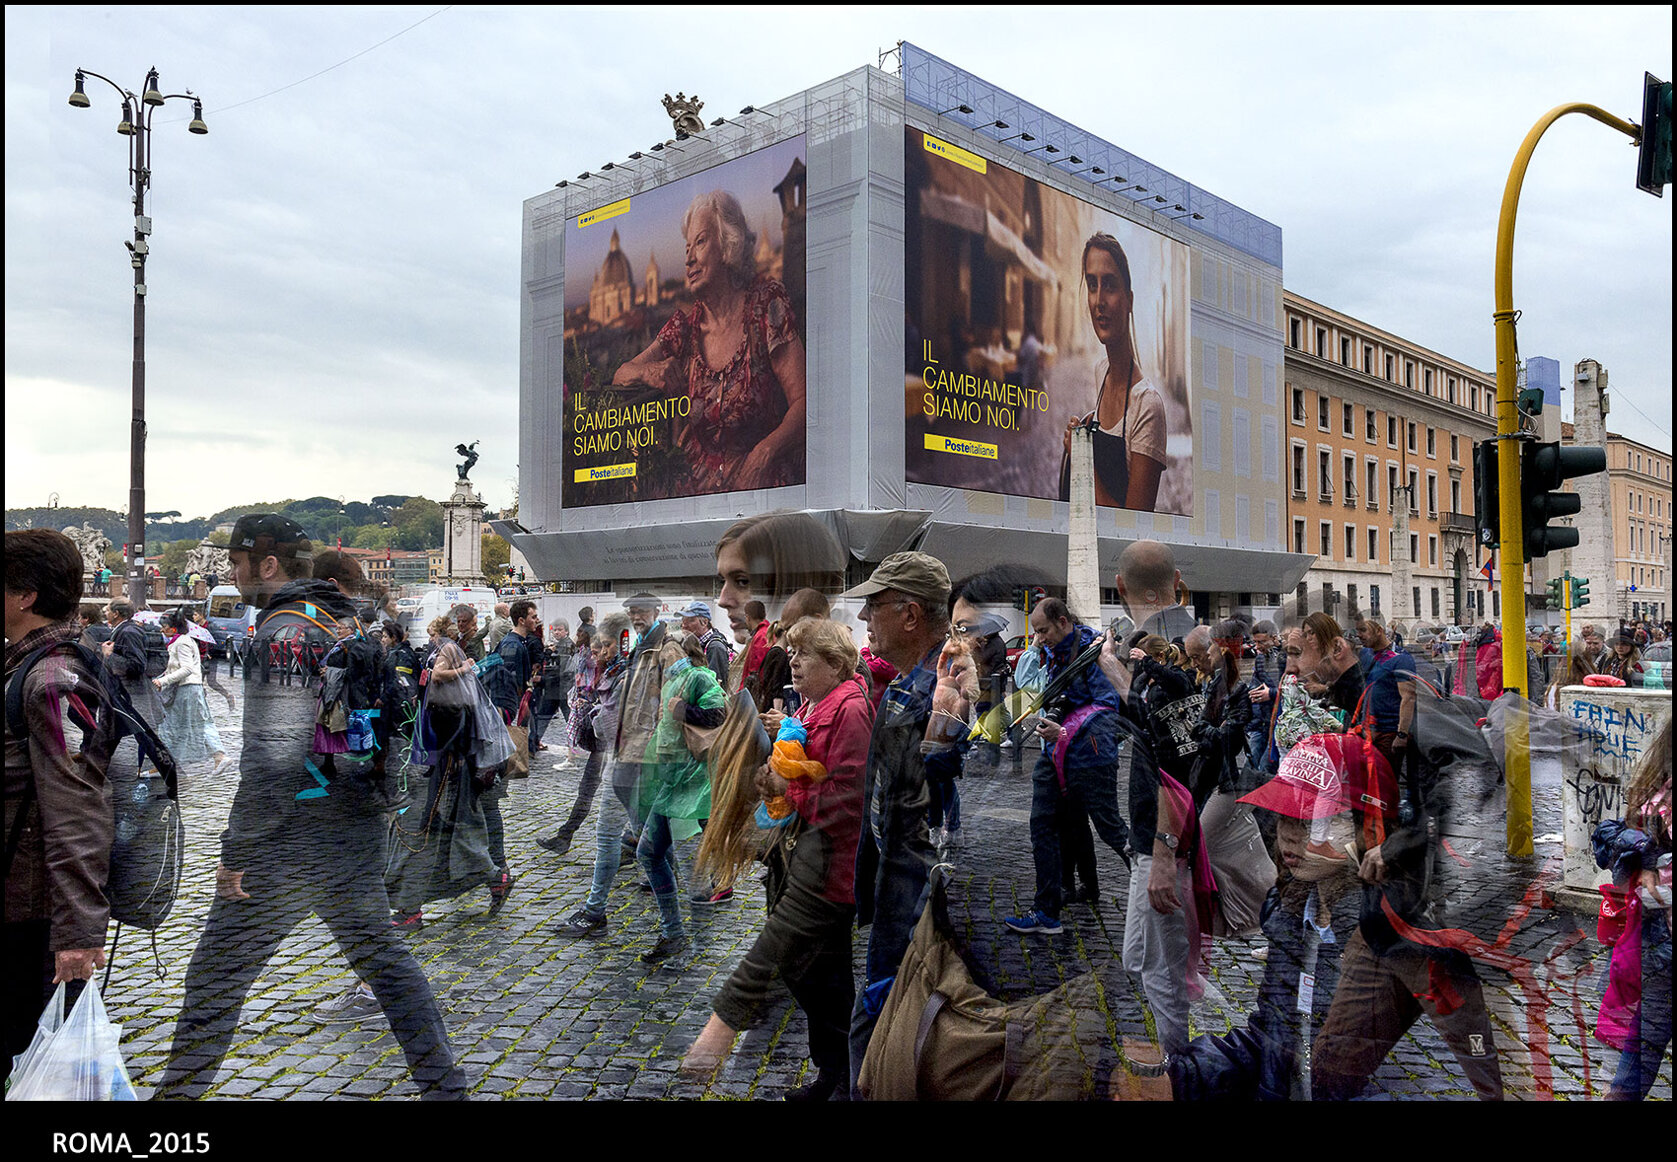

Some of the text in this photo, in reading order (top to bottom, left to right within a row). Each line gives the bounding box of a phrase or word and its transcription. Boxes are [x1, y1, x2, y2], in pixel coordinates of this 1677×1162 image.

[923, 339, 939, 364] IL
[574, 392, 587, 411] IL
[923, 366, 1049, 412] CAMBIAMENTO
[573, 395, 691, 434] CAMBIAMENTO
[923, 392, 1020, 431] SIAMO NOI.
[573, 425, 659, 457] SIAMO NOI.
